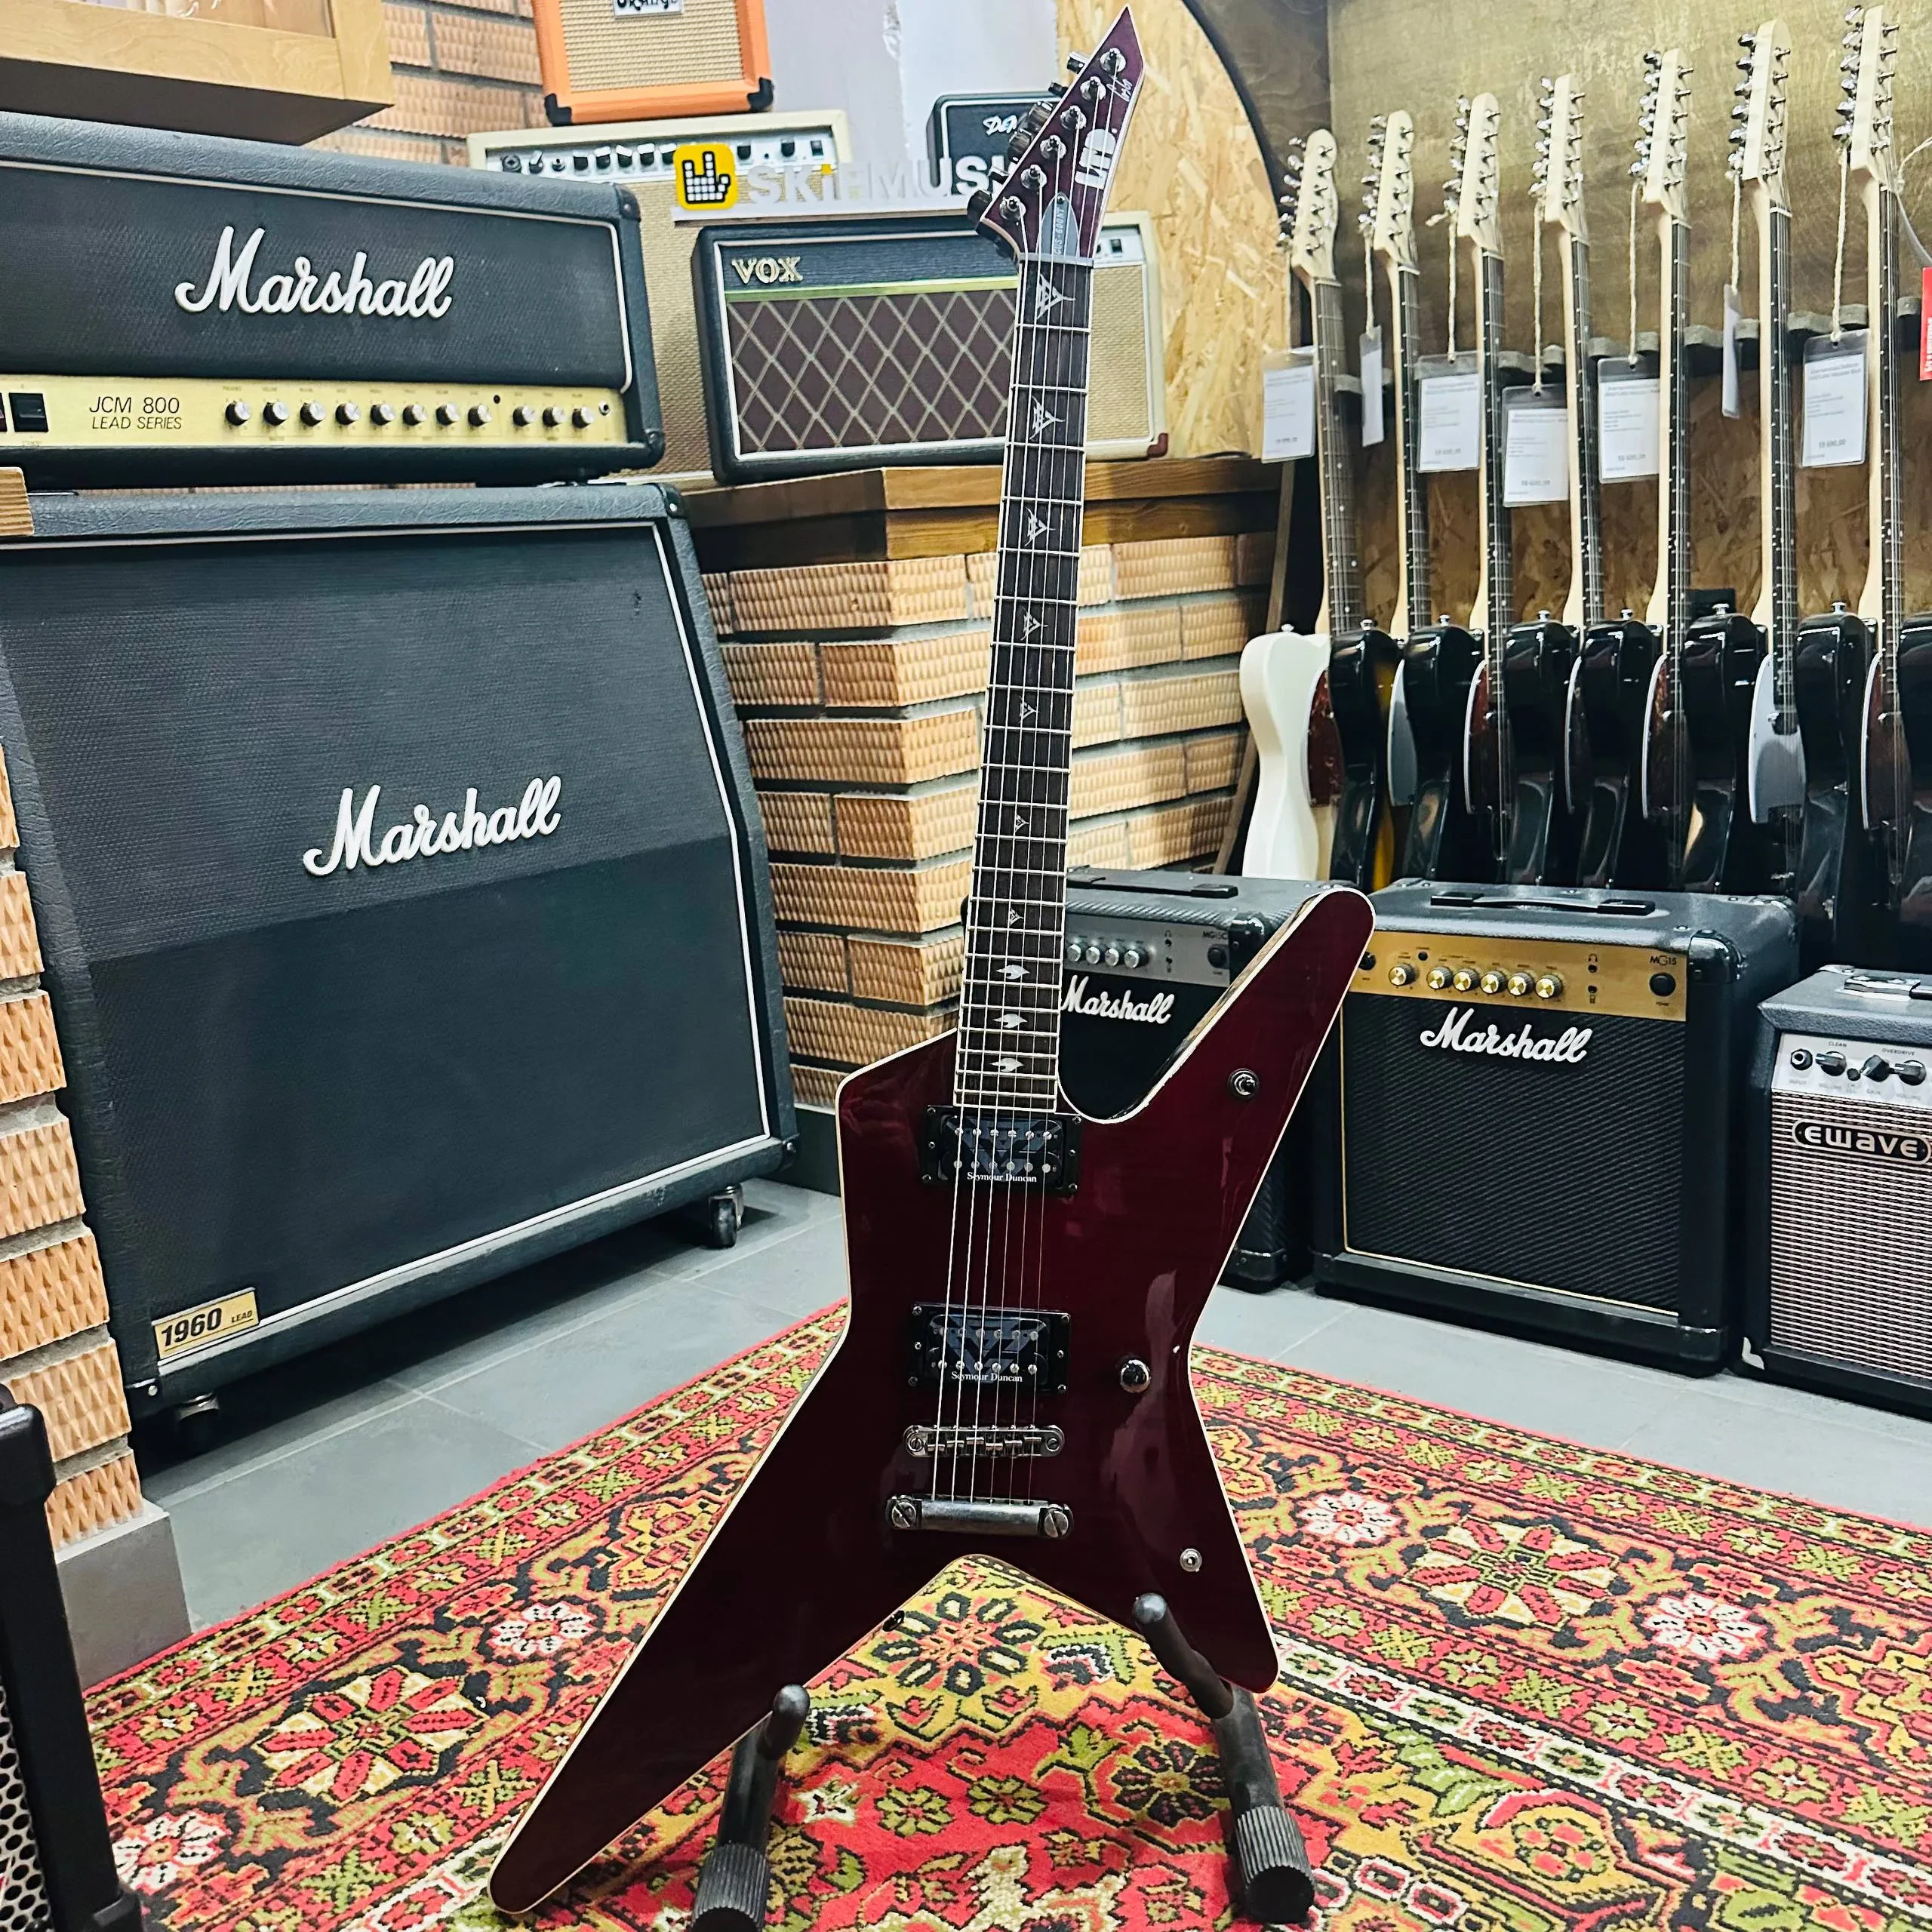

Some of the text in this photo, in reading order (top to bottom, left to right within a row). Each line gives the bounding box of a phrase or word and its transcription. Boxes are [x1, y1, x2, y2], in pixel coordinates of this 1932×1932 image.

[174, 226, 454, 318] Marshall
[731, 257, 803, 284] VOX
[89, 396, 180, 414] JCM 800
[92, 417, 182, 429] LEAD SERIES
[303, 775, 561, 876] Marshall
[1060, 975, 1175, 1024] Marshall
[1420, 1007, 1593, 1063] Marshall
[1881, 1048, 1915, 1056] OVERDRIVE
[967, 1172, 1037, 1183] Seymour Duncan
[161, 1308, 253, 1346] 1960 LEAD
[951, 1371, 1023, 1383] Seymour Duncan
